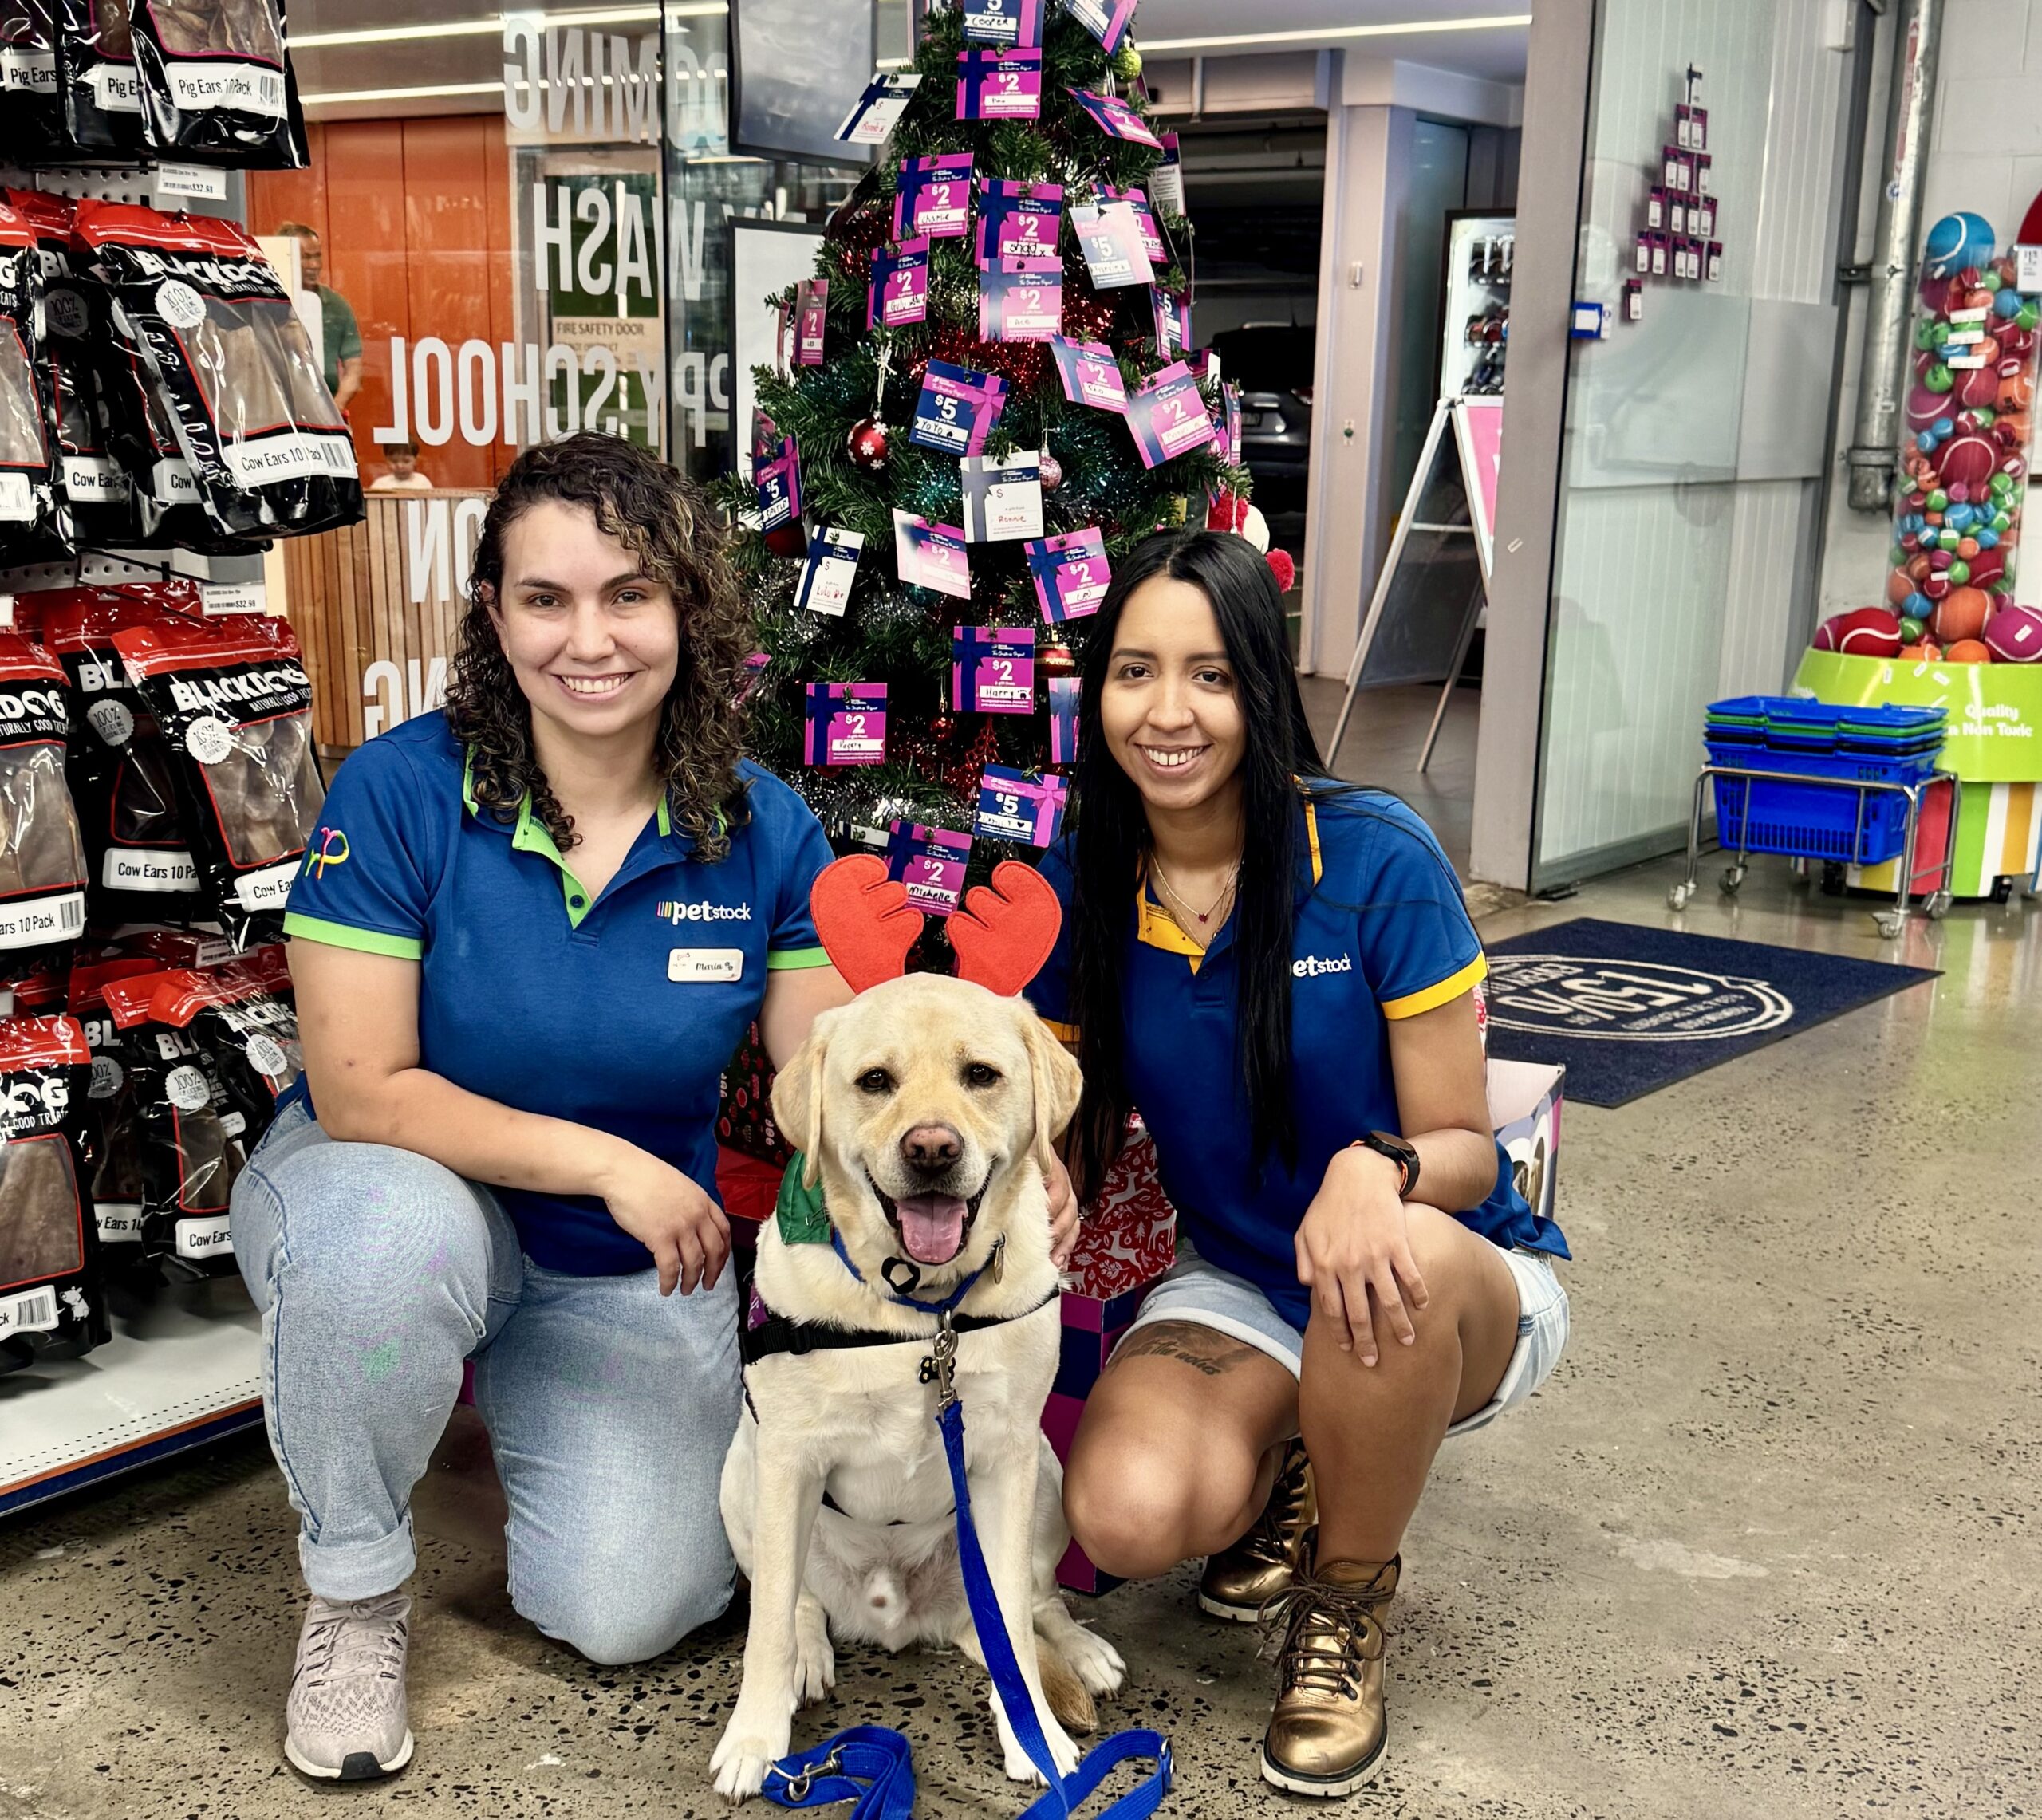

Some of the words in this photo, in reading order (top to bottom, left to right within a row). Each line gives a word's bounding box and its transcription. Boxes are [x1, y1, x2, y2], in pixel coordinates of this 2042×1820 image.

[11, 68, 31, 86] Pig
[31, 67, 57, 83] Ears
[999, 73, 1019, 91] $2
[108, 77, 127, 98] Pig
[179, 79, 198, 98] Pig
[197, 78, 223, 94] Ears
[932, 184, 950, 205] $2
[1018, 214, 1039, 237] $2
[1090, 236, 1113, 258] $5
[897, 271, 913, 292] $2
[1019, 288, 1041, 309] $2
[556, 322, 576, 335] FIRE
[578, 322, 613, 335] SAFETY
[616, 323, 645, 336] DOOR
[935, 394, 958, 420] $5
[1162, 399, 1187, 420] $2
[241, 456, 264, 471] Cow
[264, 451, 290, 467] Ears
[290, 447, 304, 463] 10
[73, 471, 96, 487] Cow
[98, 472, 116, 488] Ear
[171, 474, 191, 489] Cow
[766, 478, 779, 499] $5
[1070, 562, 1093, 583] $2
[992, 659, 1013, 681] $2
[169, 668, 309, 712] BLACKDOG
[1965, 703, 2019, 722] Quality
[846, 714, 865, 734] $2
[1963, 723, 1993, 736] Non
[1996, 721, 2032, 738] Toxic
[995, 792, 1019, 814] $5
[119, 862, 140, 877] Cow
[144, 864, 168, 879] Ears
[171, 865, 183, 879] 10
[924, 859, 944, 882] $2
[253, 884, 276, 900] Cow
[19, 917, 30, 932] 10
[33, 912, 55, 930] Pack
[672, 900, 751, 926] petstock
[1292, 952, 1352, 977] etstock
[1495, 970, 1713, 1021] 15%
[175, 1071, 202, 1090] 100%
[13, 1115, 36, 1130] GOOD
[104, 1216, 128, 1231] Ears
[189, 1233, 211, 1247] Cow
[213, 1230, 232, 1244] Ears
